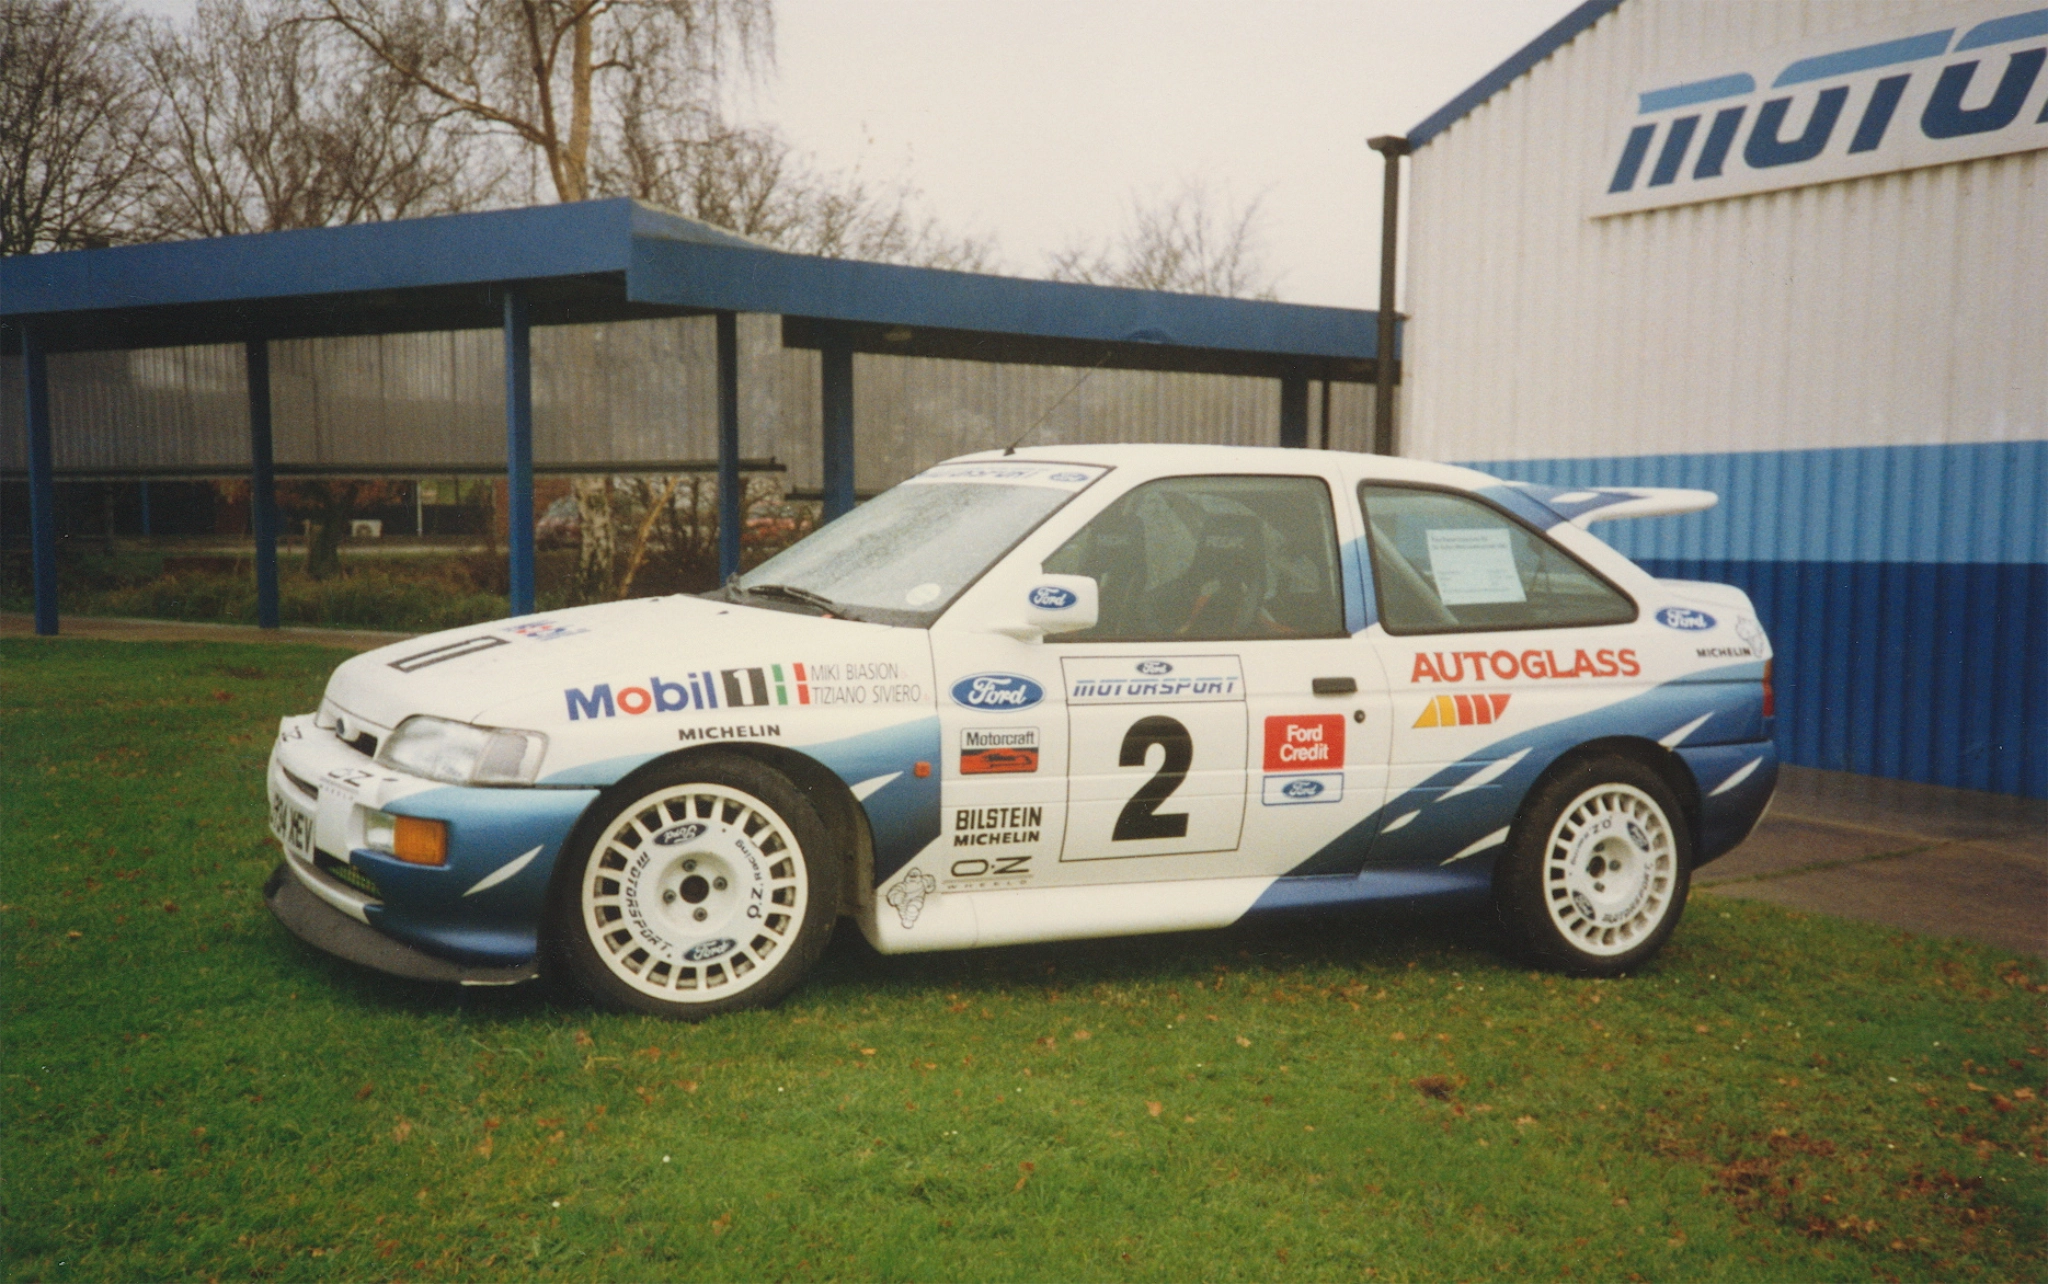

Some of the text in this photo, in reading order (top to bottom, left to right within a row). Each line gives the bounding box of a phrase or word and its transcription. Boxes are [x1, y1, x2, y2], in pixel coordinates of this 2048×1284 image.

[1607, 7, 2048, 195] MOTO
[1666, 608, 1708, 629] Ford
[1696, 647, 1751, 658] MICHELIN
[811, 662, 899, 681] MIKI BIASION
[1411, 648, 1641, 683] AUTOGLASS
[564, 671, 718, 721] Mobil
[812, 683, 921, 705] TIZIANO SIVIERO
[1072, 676, 1239, 697] MOTORSPORT
[678, 724, 781, 741] MICHELIN
[966, 731, 1035, 746] Motorcraft
[1286, 723, 1323, 742] Ford
[1280, 743, 1329, 762] Credit
[1112, 715, 1194, 842] 2
[955, 806, 1042, 831] BILSTEIN
[953, 830, 1040, 847] MICHELIN
[734, 839, 763, 881] Racing
[625, 850, 673, 951] MOTORSPORT
